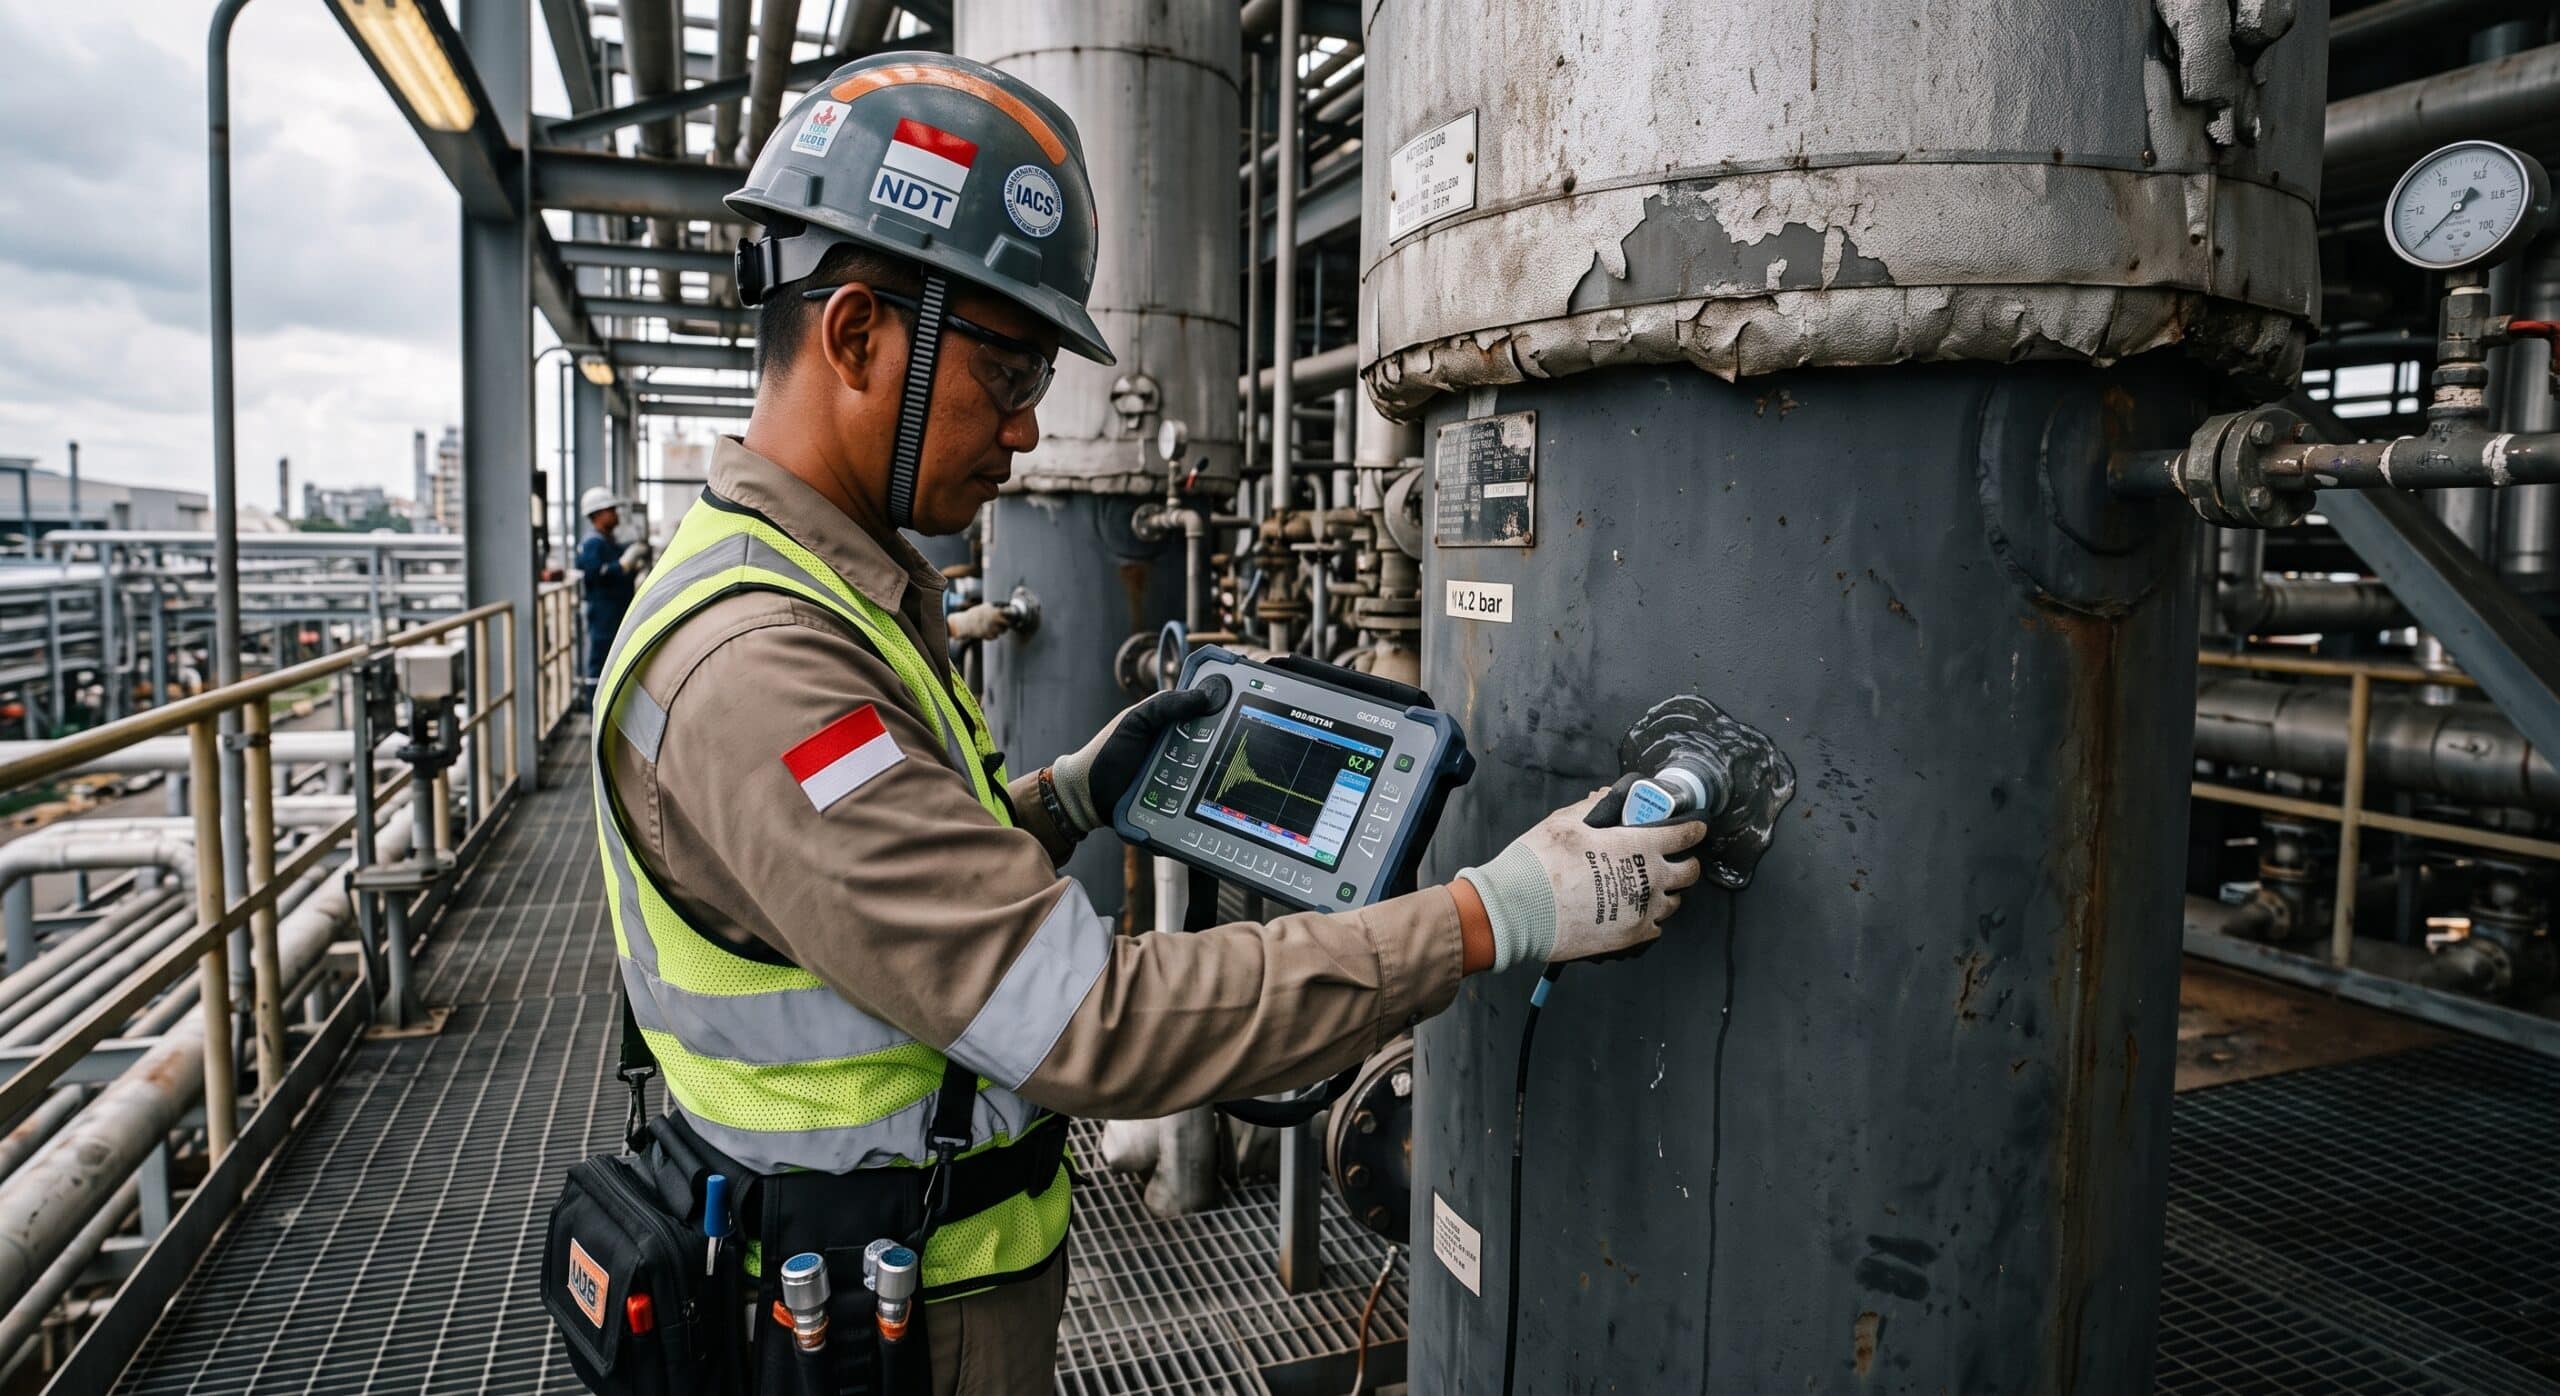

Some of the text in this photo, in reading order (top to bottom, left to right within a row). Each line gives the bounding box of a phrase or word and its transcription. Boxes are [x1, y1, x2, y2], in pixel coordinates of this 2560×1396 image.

[876, 174, 953, 220] NDT
[1016, 184, 1054, 217] IACS
[1479, 591, 1503, 614] bar
